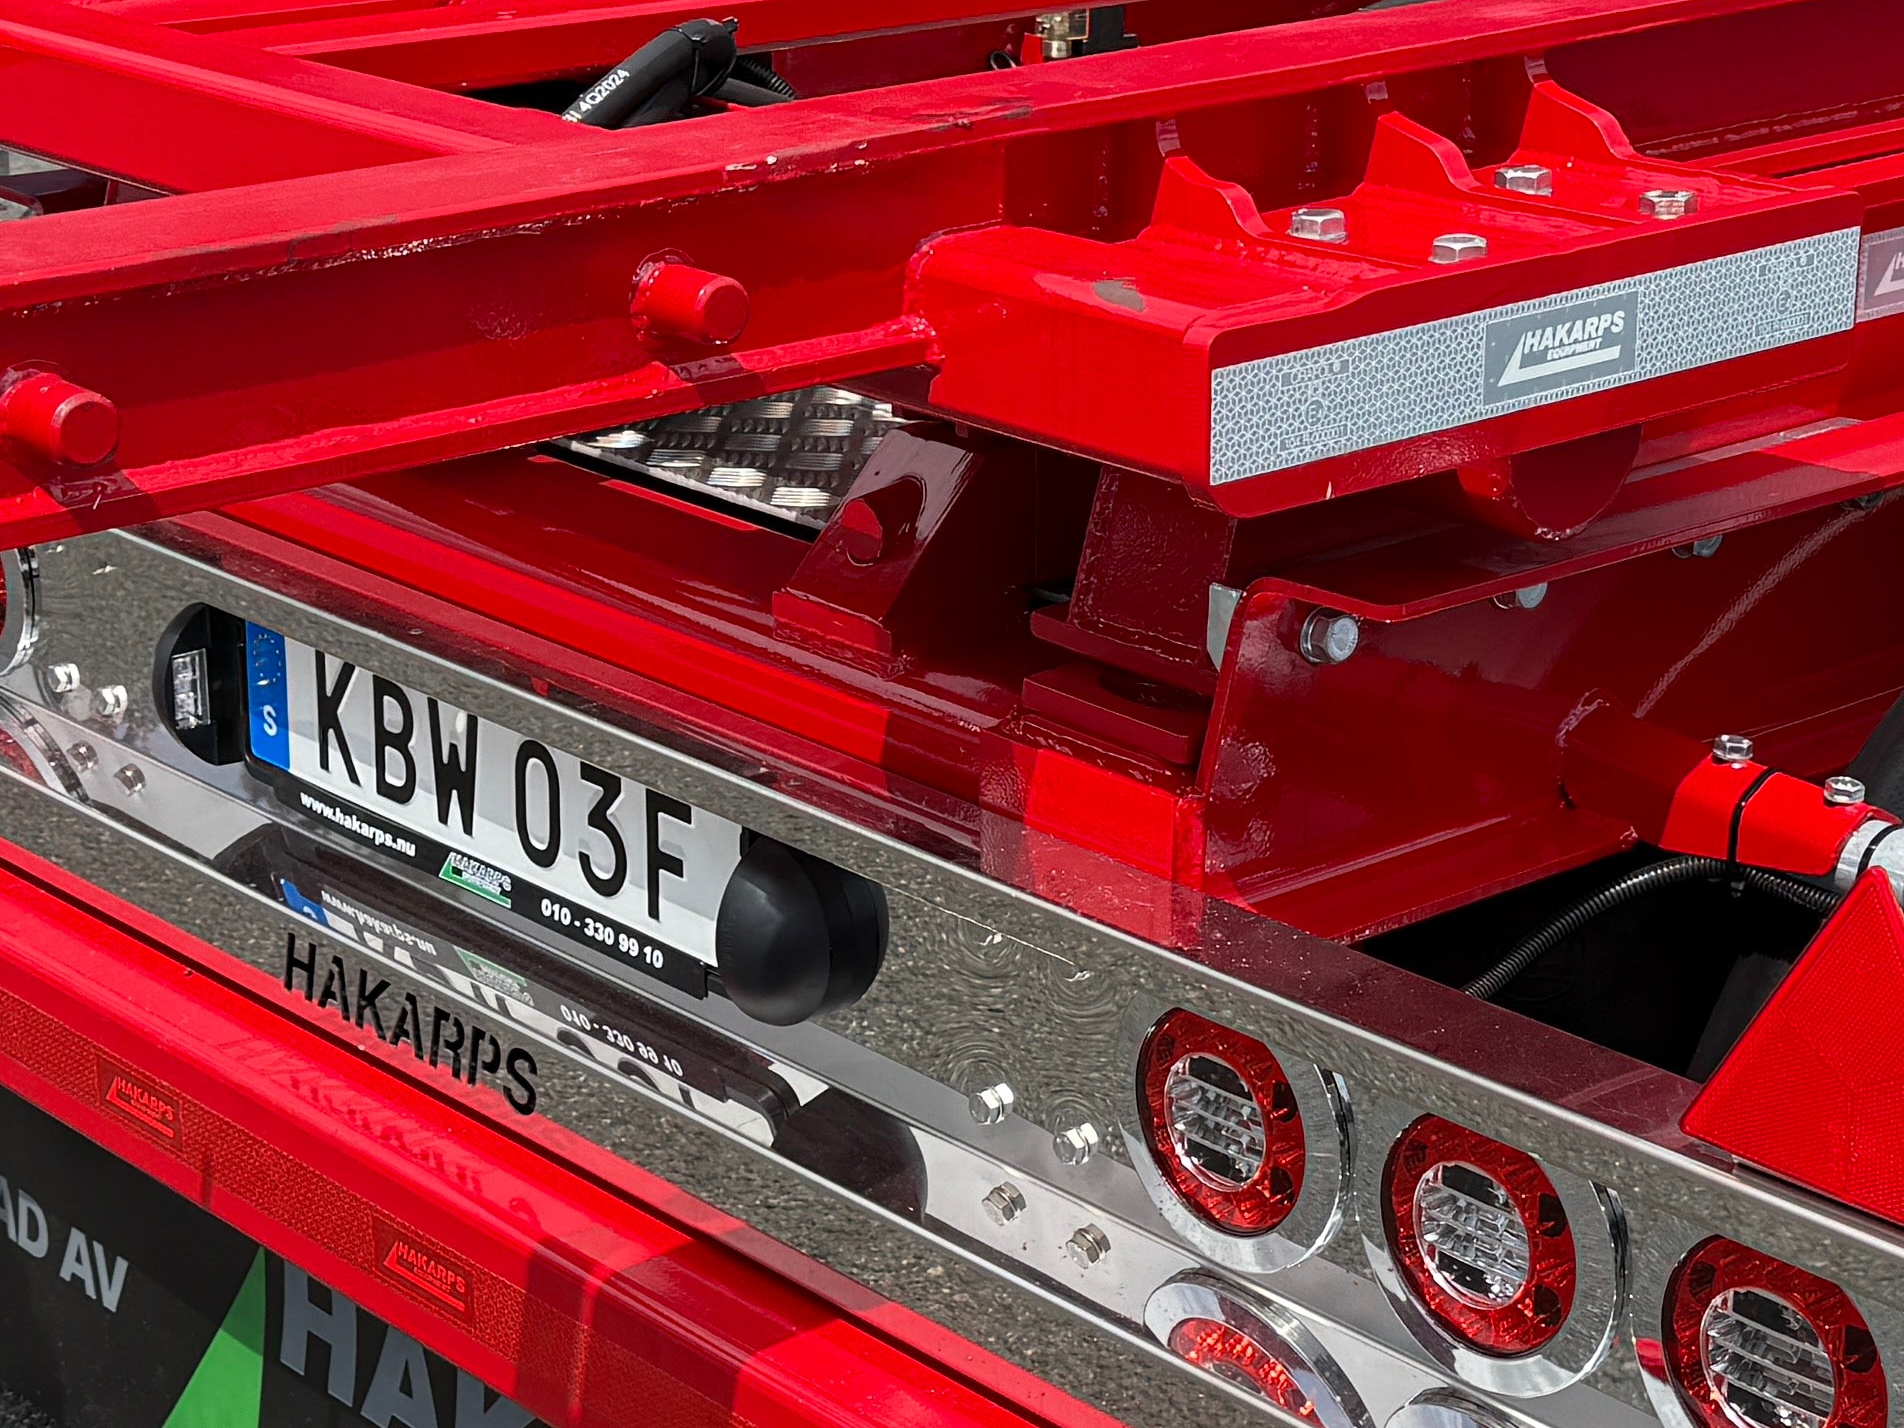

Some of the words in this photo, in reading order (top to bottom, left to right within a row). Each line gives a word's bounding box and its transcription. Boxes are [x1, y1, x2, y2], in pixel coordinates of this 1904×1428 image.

[579, 69, 631, 112] 4Q2024
[1523, 309, 1626, 354] HAKARPS
[1546, 336, 1602, 362] EQUIPMENT
[261, 704, 278, 737] S
[315, 650, 479, 838] KBW
[513, 738, 693, 922] 03F
[299, 791, 417, 858] www.hakarps.nu
[540, 898, 572, 926] 010
[583, 917, 615, 946] 330
[618, 933, 640, 958] 99
[643, 945, 664, 969] 10
[283, 932, 539, 1117] HAKARPS
[116, 1075, 175, 1122] HAKARPS
[59, 1226, 130, 1313] AV
[398, 1239, 468, 1296] HAKARPS
